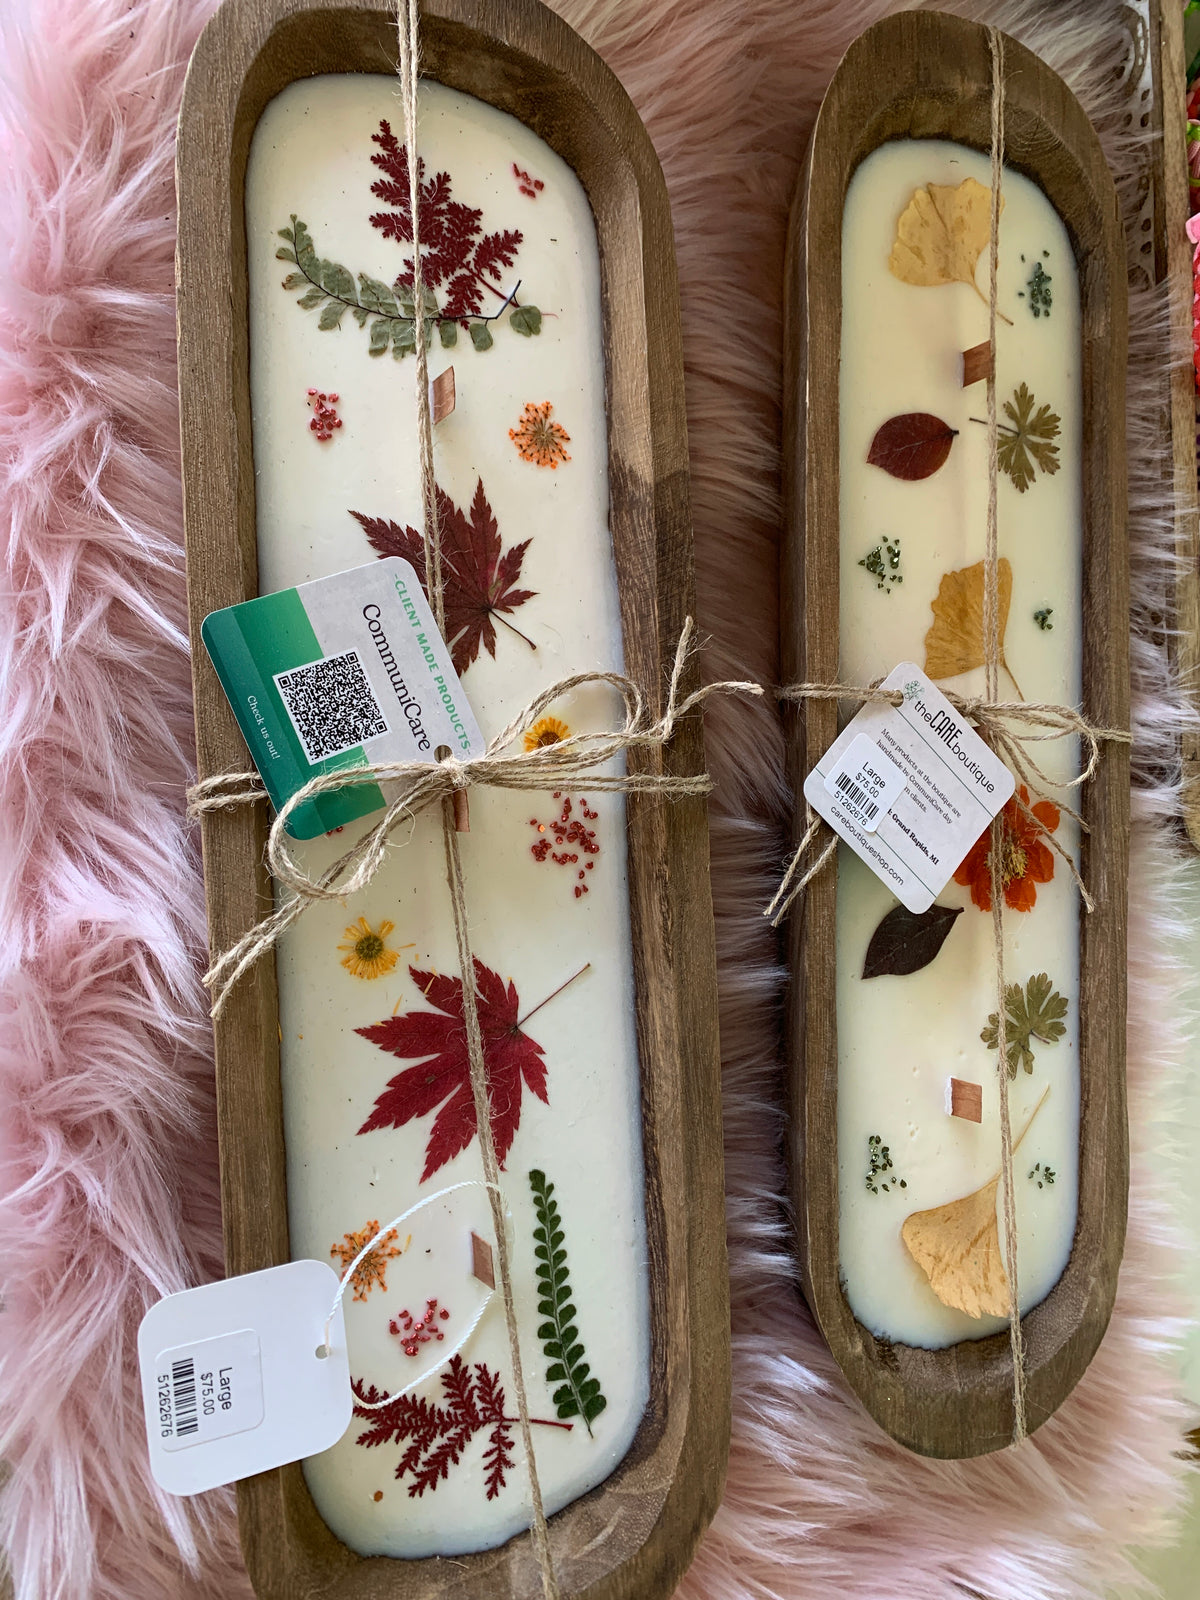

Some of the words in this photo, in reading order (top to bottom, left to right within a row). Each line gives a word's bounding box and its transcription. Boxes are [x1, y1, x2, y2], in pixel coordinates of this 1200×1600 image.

[416, 633, 438, 672] MADE
[362, 604, 431, 752] CommuniCare
[247, 695, 265, 726] Check
[260, 727, 271, 741] us
[266, 738, 280, 760] out!
[854, 772, 880, 799] $75.00
[862, 761, 886, 788] Large
[876, 739, 904, 770] handmade
[908, 774, 944, 814] CommuniCare
[942, 811, 953, 824] day
[881, 728, 897, 746] Many
[894, 745, 918, 770] products
[916, 768, 924, 777] at
[923, 774, 932, 786] the
[932, 784, 952, 808] boutique
[952, 806, 962, 818] are
[834, 790, 868, 826] 51262676
[910, 792, 927, 813] clients.
[830, 805, 905, 886] careboutiqueshop.com
[892, 813, 911, 834] Grand
[908, 832, 930, 857] Rapids,
[929, 854, 940, 866] MI
[157, 1374, 174, 1438] 51262676
[200, 1372, 215, 1416] $75.00
[217, 1367, 232, 1410] Large
